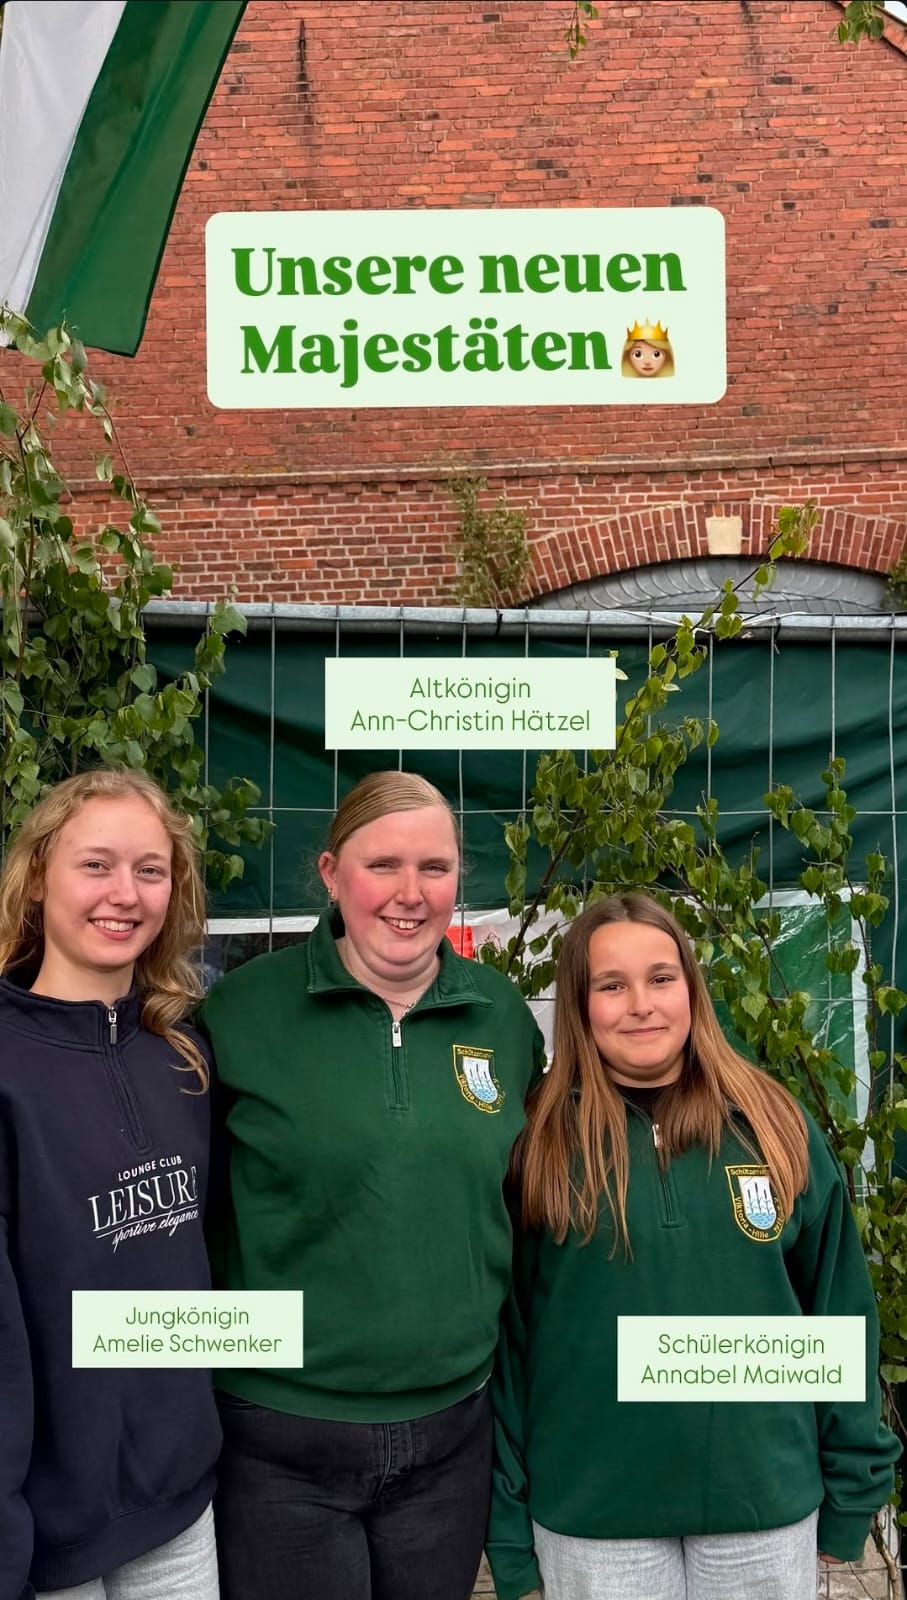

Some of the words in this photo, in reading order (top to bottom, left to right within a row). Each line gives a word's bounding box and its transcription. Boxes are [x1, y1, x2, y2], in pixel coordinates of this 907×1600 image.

[118, 1160, 157, 1182] LOUNGE
[159, 1155, 182, 1168] CLUB
[112, 1221, 157, 1253] sportive
[157, 1209, 199, 1237] elegance
